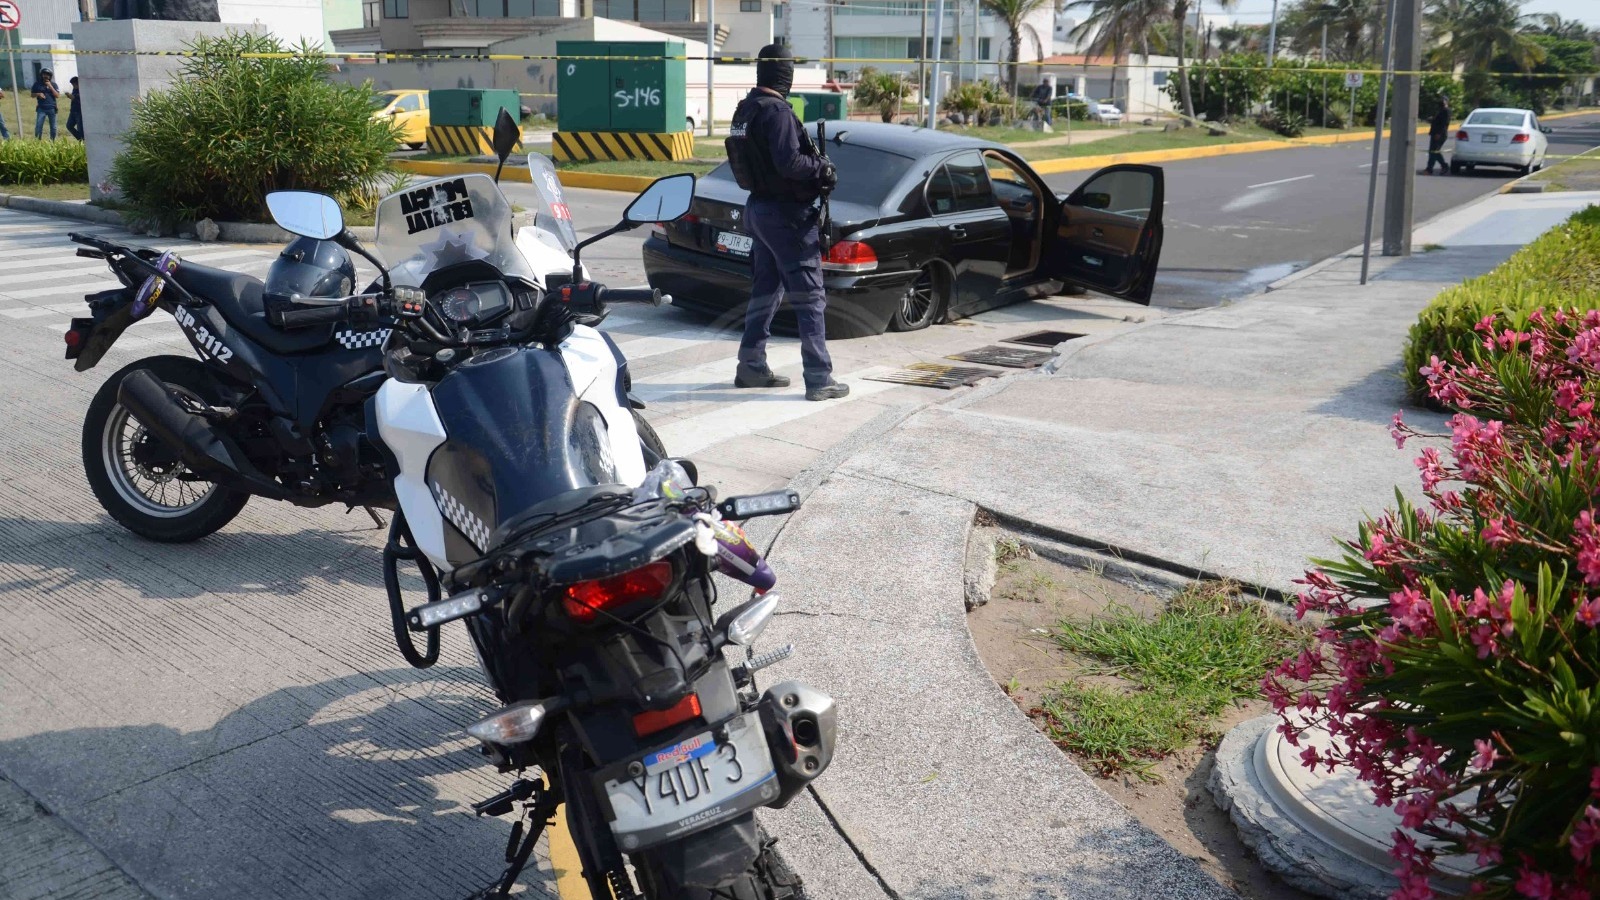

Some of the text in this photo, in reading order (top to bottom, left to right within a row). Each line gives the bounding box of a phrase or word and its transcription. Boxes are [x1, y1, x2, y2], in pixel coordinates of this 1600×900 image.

[614, 87, 660, 107] S-146
[553, 204, 571, 220] 911
[174, 304, 233, 364] SP-3112
[656, 737, 701, 763] Red Bull
[679, 806, 722, 827] VERACRUZ
